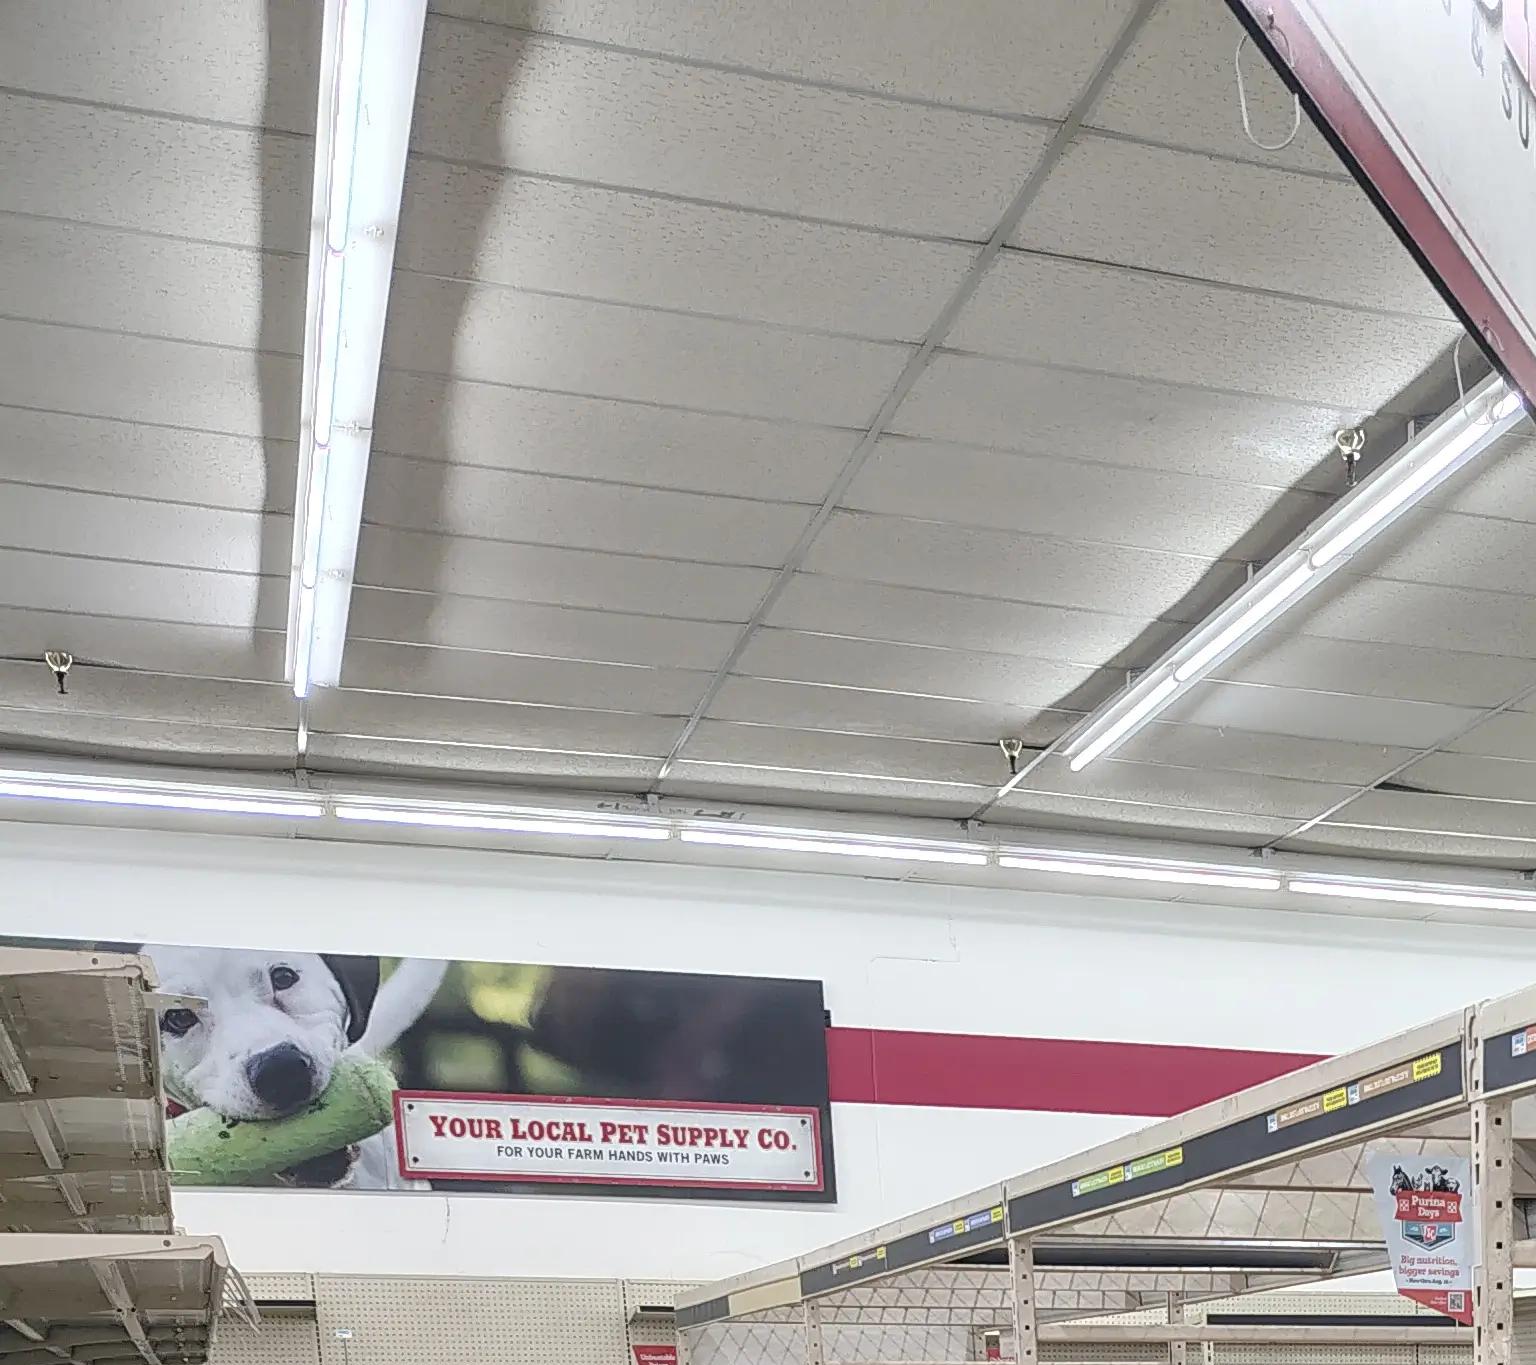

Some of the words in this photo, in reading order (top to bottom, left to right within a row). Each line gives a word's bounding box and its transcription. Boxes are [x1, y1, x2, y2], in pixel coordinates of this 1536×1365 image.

[429, 1115, 503, 1140] YOUR
[511, 1118, 592, 1143] LOCAL
[600, 1121, 649, 1146] PET
[656, 1124, 750, 1149] SUPPLY
[757, 1129, 798, 1151] CO.
[497, 1145, 523, 1157] FOR
[527, 1146, 565, 1159] YOUR
[568, 1148, 604, 1161] FARM
[608, 1150, 654, 1163] HANDS
[656, 1152, 690, 1164] WITH
[694, 1153, 730, 1166] PAWS
[1411, 1194, 1446, 1207] Purina
[1418, 1206, 1440, 1219] Days
[1401, 1255, 1415, 1266] Big
[1399, 1266, 1427, 1277] bigger
[1428, 1268, 1460, 1278] savings
